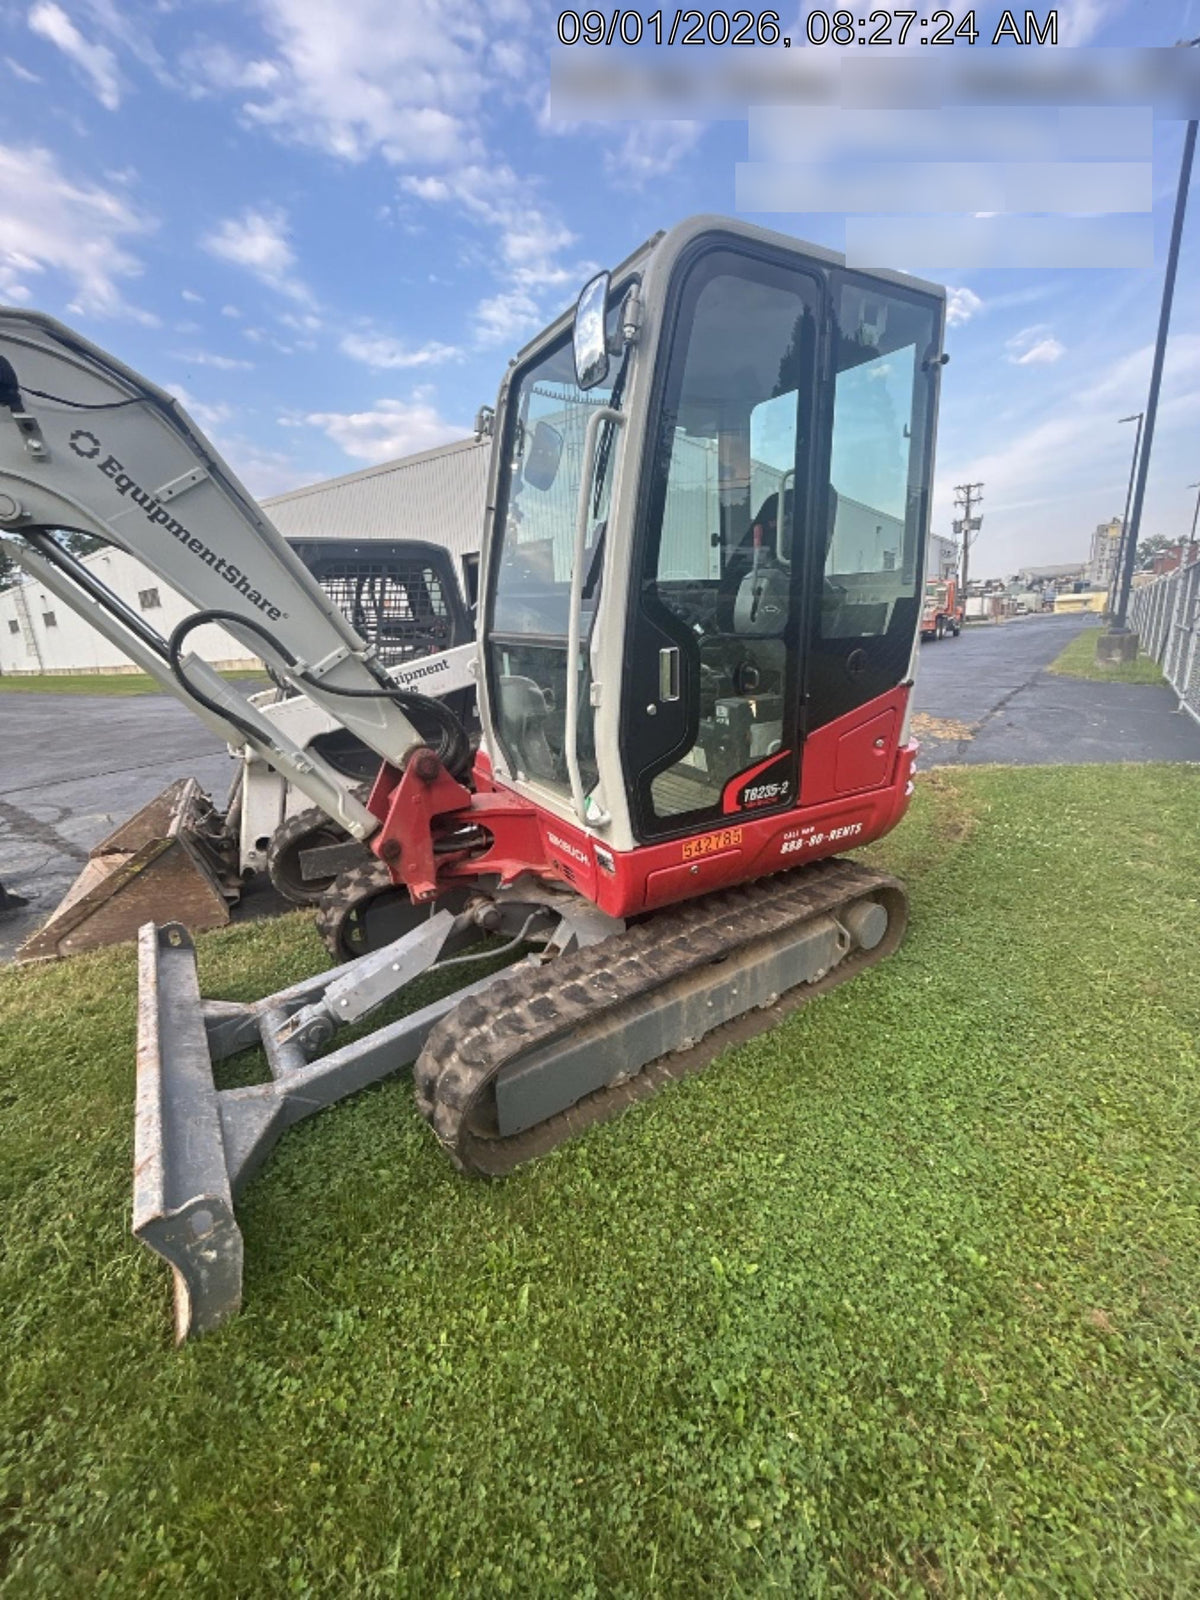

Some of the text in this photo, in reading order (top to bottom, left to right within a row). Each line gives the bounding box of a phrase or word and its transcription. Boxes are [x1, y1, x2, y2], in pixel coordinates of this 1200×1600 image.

[97, 455, 283, 621] EquipmentShare
[744, 781, 789, 802] TB235-2
[684, 829, 741, 858] 542785
